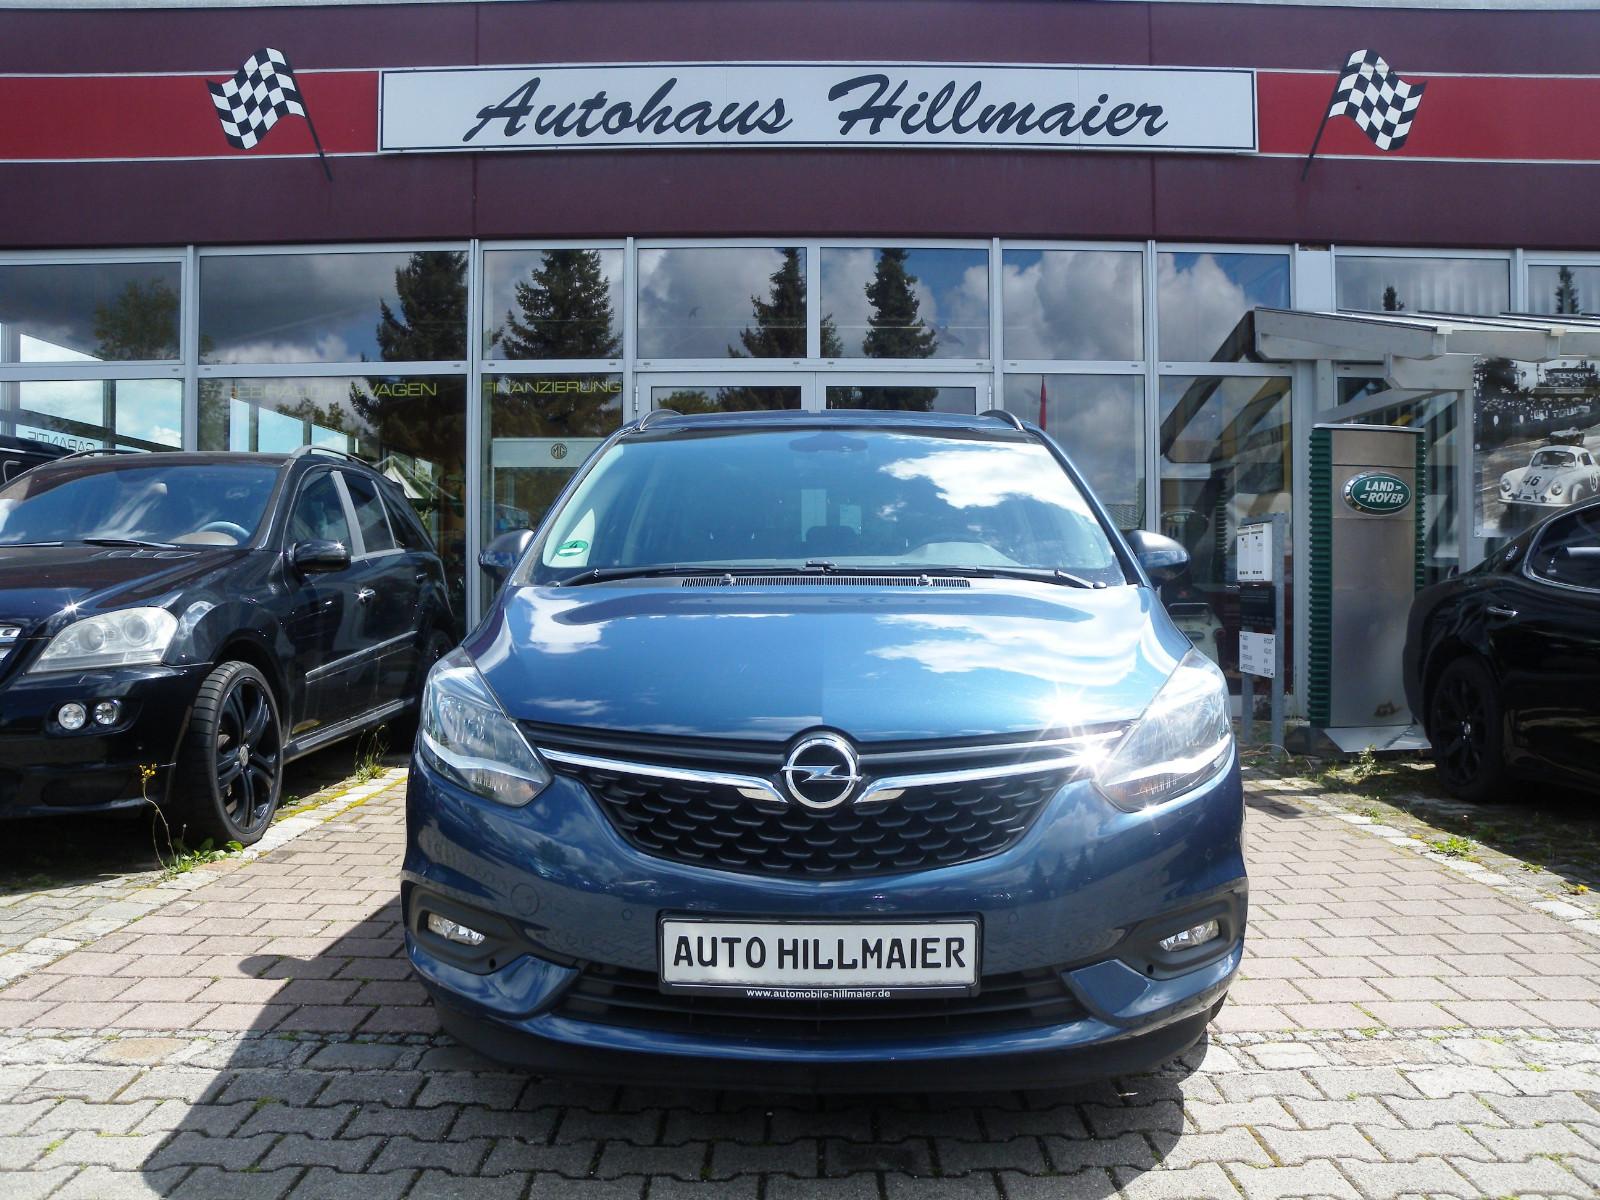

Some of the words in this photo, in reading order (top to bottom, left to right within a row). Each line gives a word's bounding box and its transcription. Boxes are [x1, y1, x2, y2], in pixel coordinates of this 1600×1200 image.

[462, 76, 793, 142] Autohaus
[828, 73, 1168, 137] Hillmaier
[483, 380, 623, 394] FINANZIERUNG
[550, 442, 568, 460] MG
[1364, 480, 1395, 492] LAND
[1367, 492, 1405, 504] ROVER
[673, 935, 766, 968] AUTO
[777, 937, 966, 970] HILLMAIER
[746, 988, 891, 999] www.automobile-hillmaier.de
